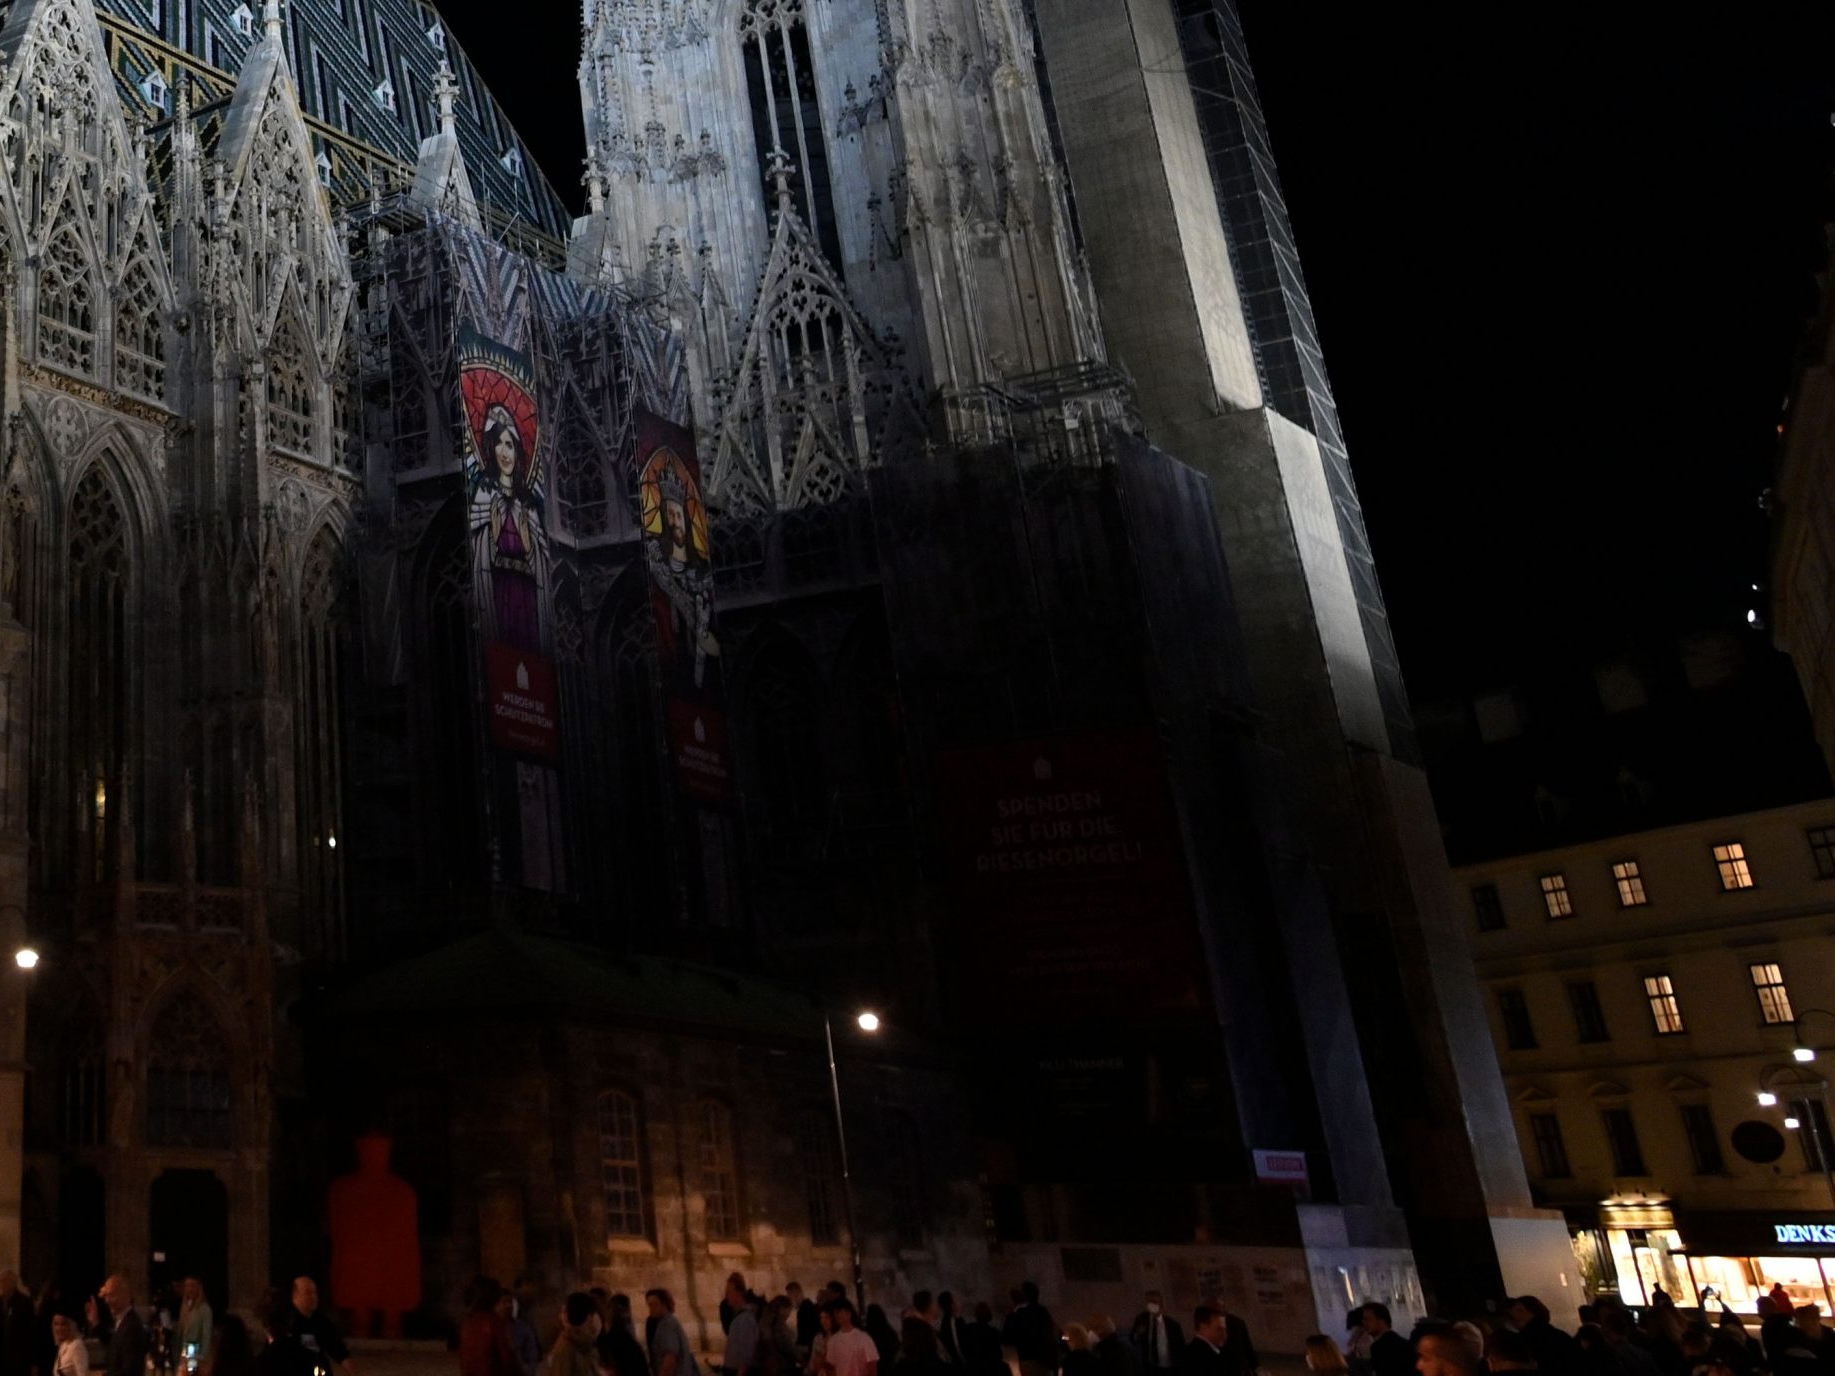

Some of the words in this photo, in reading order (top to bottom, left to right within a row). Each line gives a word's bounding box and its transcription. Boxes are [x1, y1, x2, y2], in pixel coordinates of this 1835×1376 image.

[997, 789, 1102, 819] SPENDEN
[991, 824, 1024, 848] SIE
[1030, 814, 1073, 841] FÜR
[1079, 815, 1119, 838] DIE
[976, 840, 1143, 873] RIESENORGEL!
